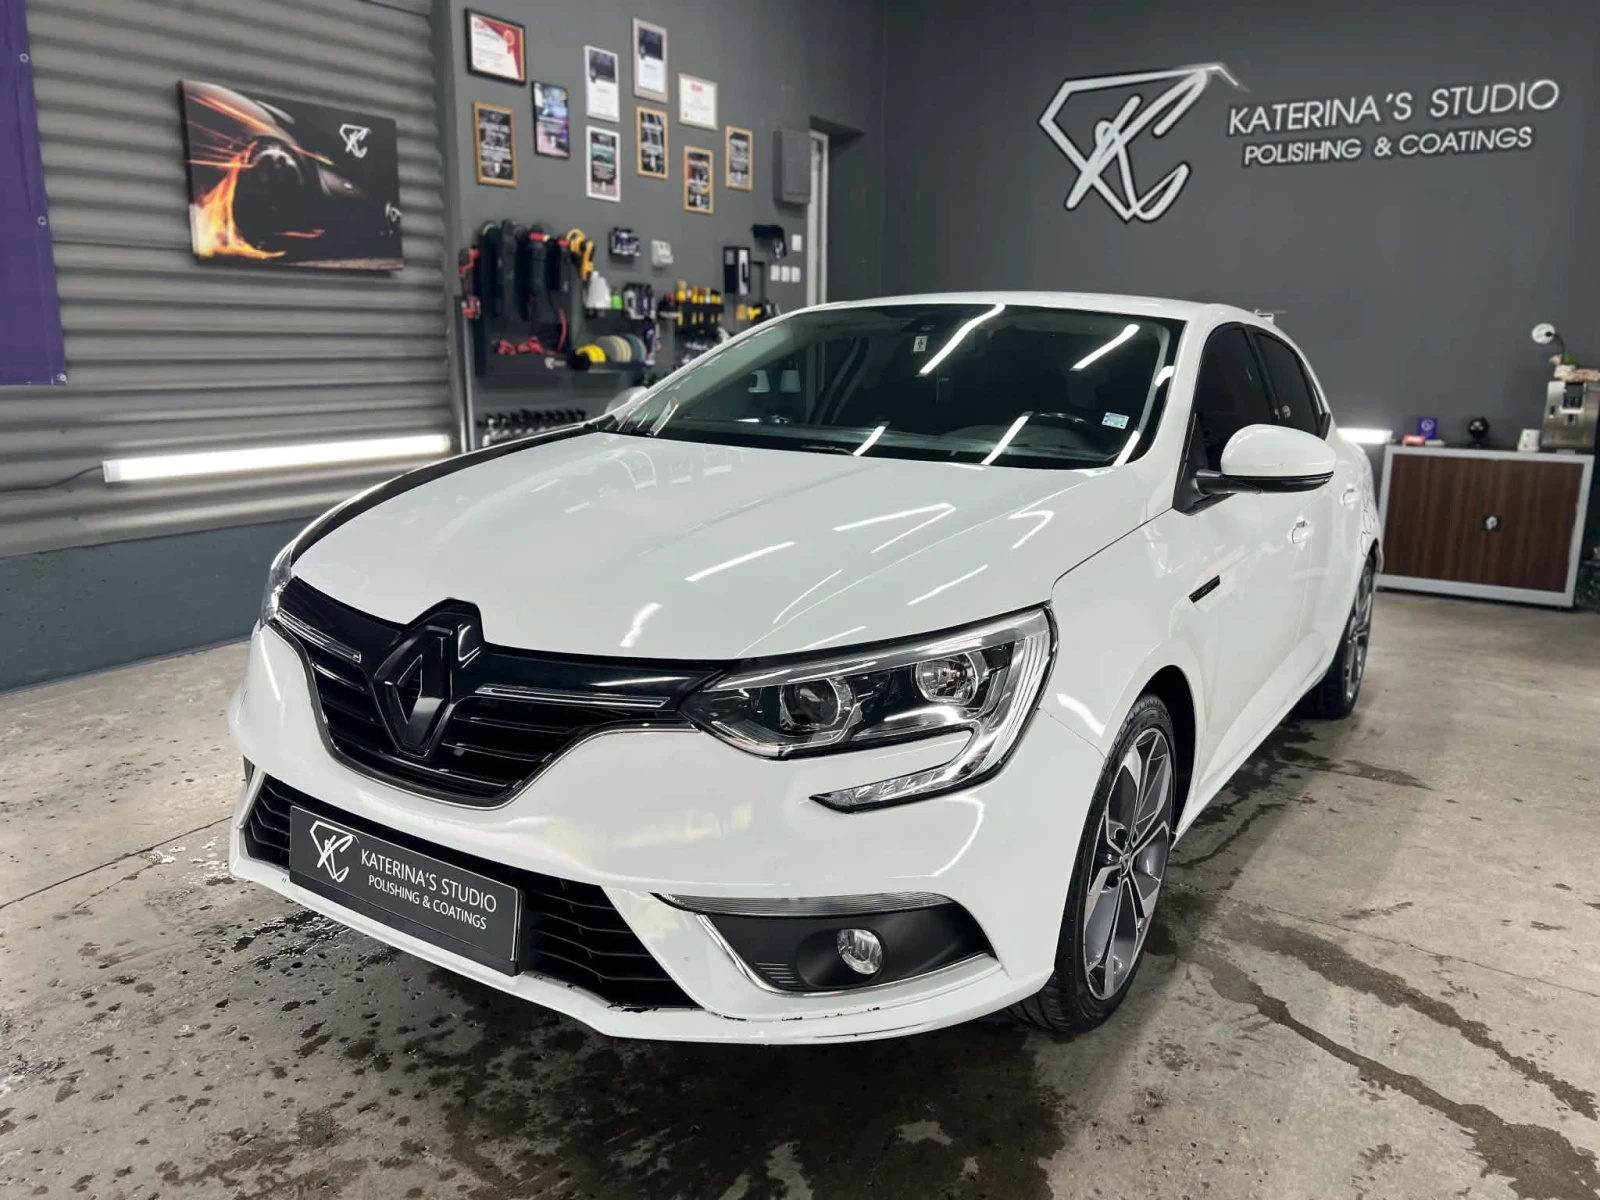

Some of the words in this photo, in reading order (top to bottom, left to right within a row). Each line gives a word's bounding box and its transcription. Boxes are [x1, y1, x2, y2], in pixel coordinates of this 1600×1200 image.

[1229, 91, 1413, 136] KATERINA'S
[1429, 79, 1560, 118] STUDIO
[1374, 136, 1393, 158] &
[1398, 126, 1532, 155] COATINGS
[361, 848, 438, 891] KATERINA'S
[441, 878, 497, 913] STUDIO
[368, 874, 420, 904] POLISHING
[422, 895, 431, 909] &
[433, 899, 487, 930] COATINGS
